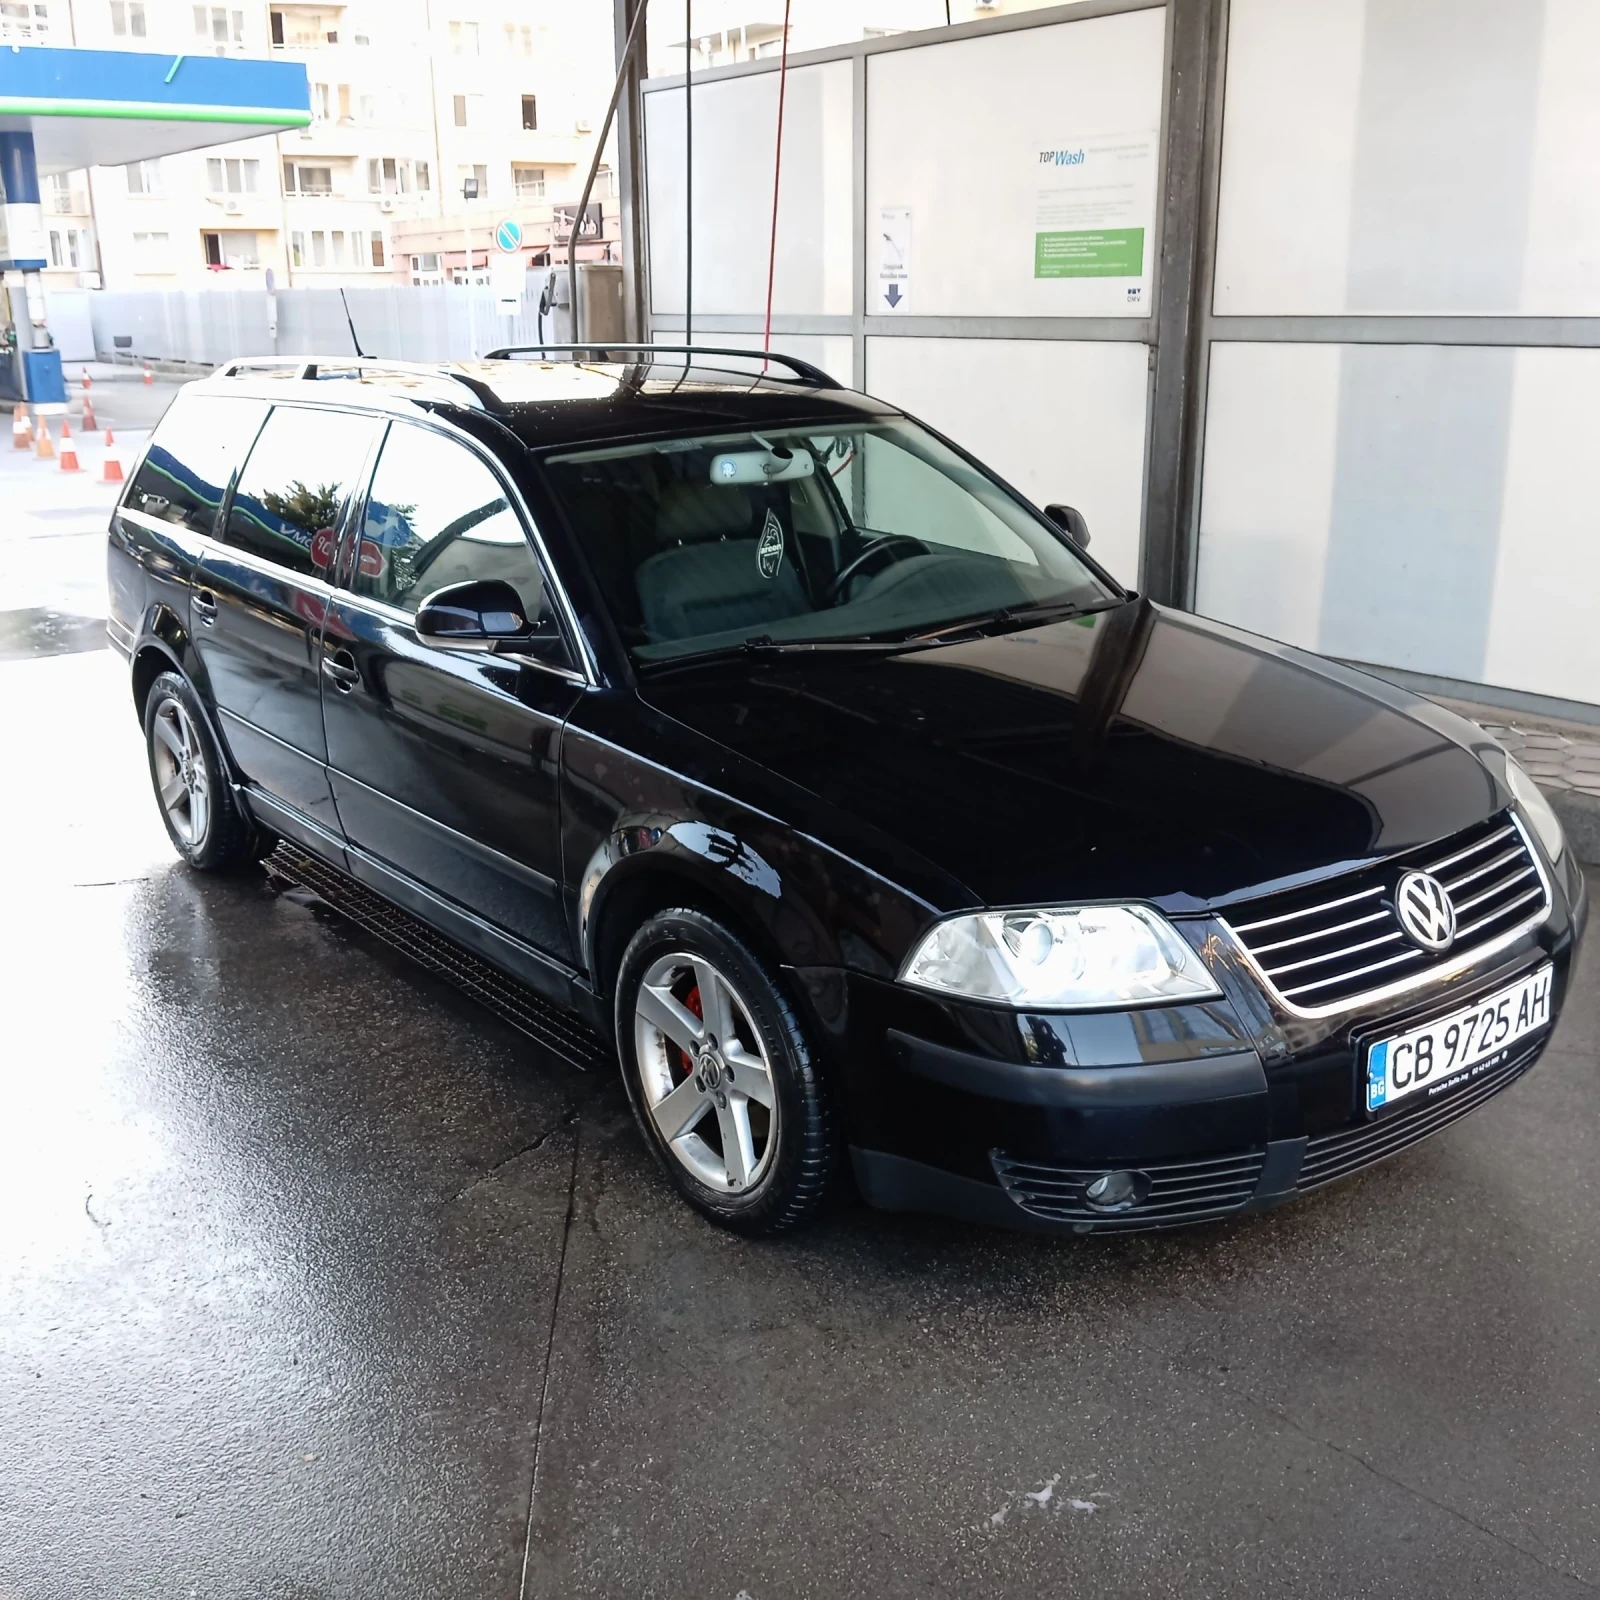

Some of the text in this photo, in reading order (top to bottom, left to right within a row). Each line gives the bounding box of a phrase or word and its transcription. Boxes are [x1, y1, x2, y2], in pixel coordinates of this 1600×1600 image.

[1039, 151, 1055, 163] TOP
[1055, 148, 1085, 165] Wash
[760, 543, 782, 554] areon
[1391, 976, 1549, 1090] CB 9725 AH
[1370, 1080, 1385, 1097] BG
